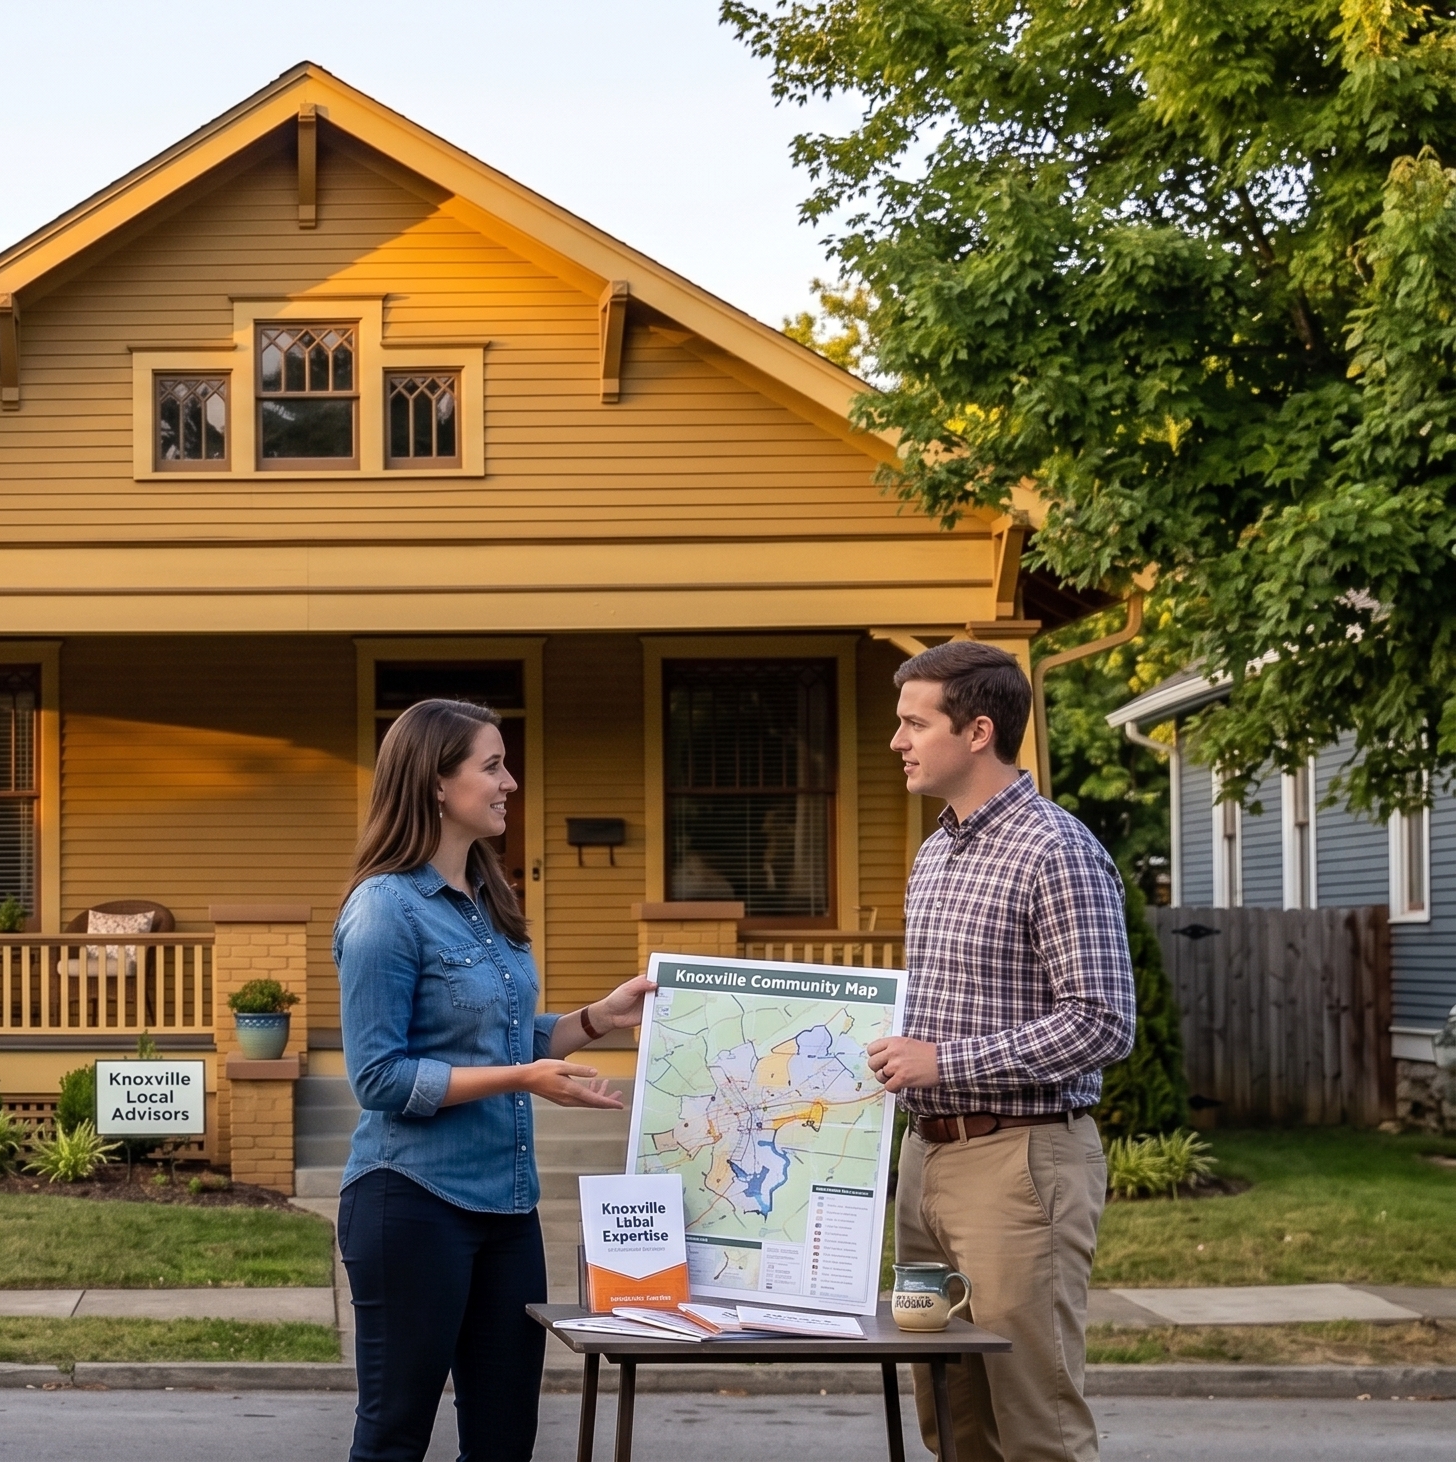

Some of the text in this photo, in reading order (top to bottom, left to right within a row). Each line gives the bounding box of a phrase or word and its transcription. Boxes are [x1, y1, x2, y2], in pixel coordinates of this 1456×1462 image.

[675, 969, 878, 999] Knoxville Community Map
[109, 1071, 191, 1086] Knoxville
[126, 1090, 174, 1104] Local
[111, 1107, 190, 1121] Advisors
[602, 1201, 666, 1215] Knoxville
[602, 1229, 669, 1245] Expertise
